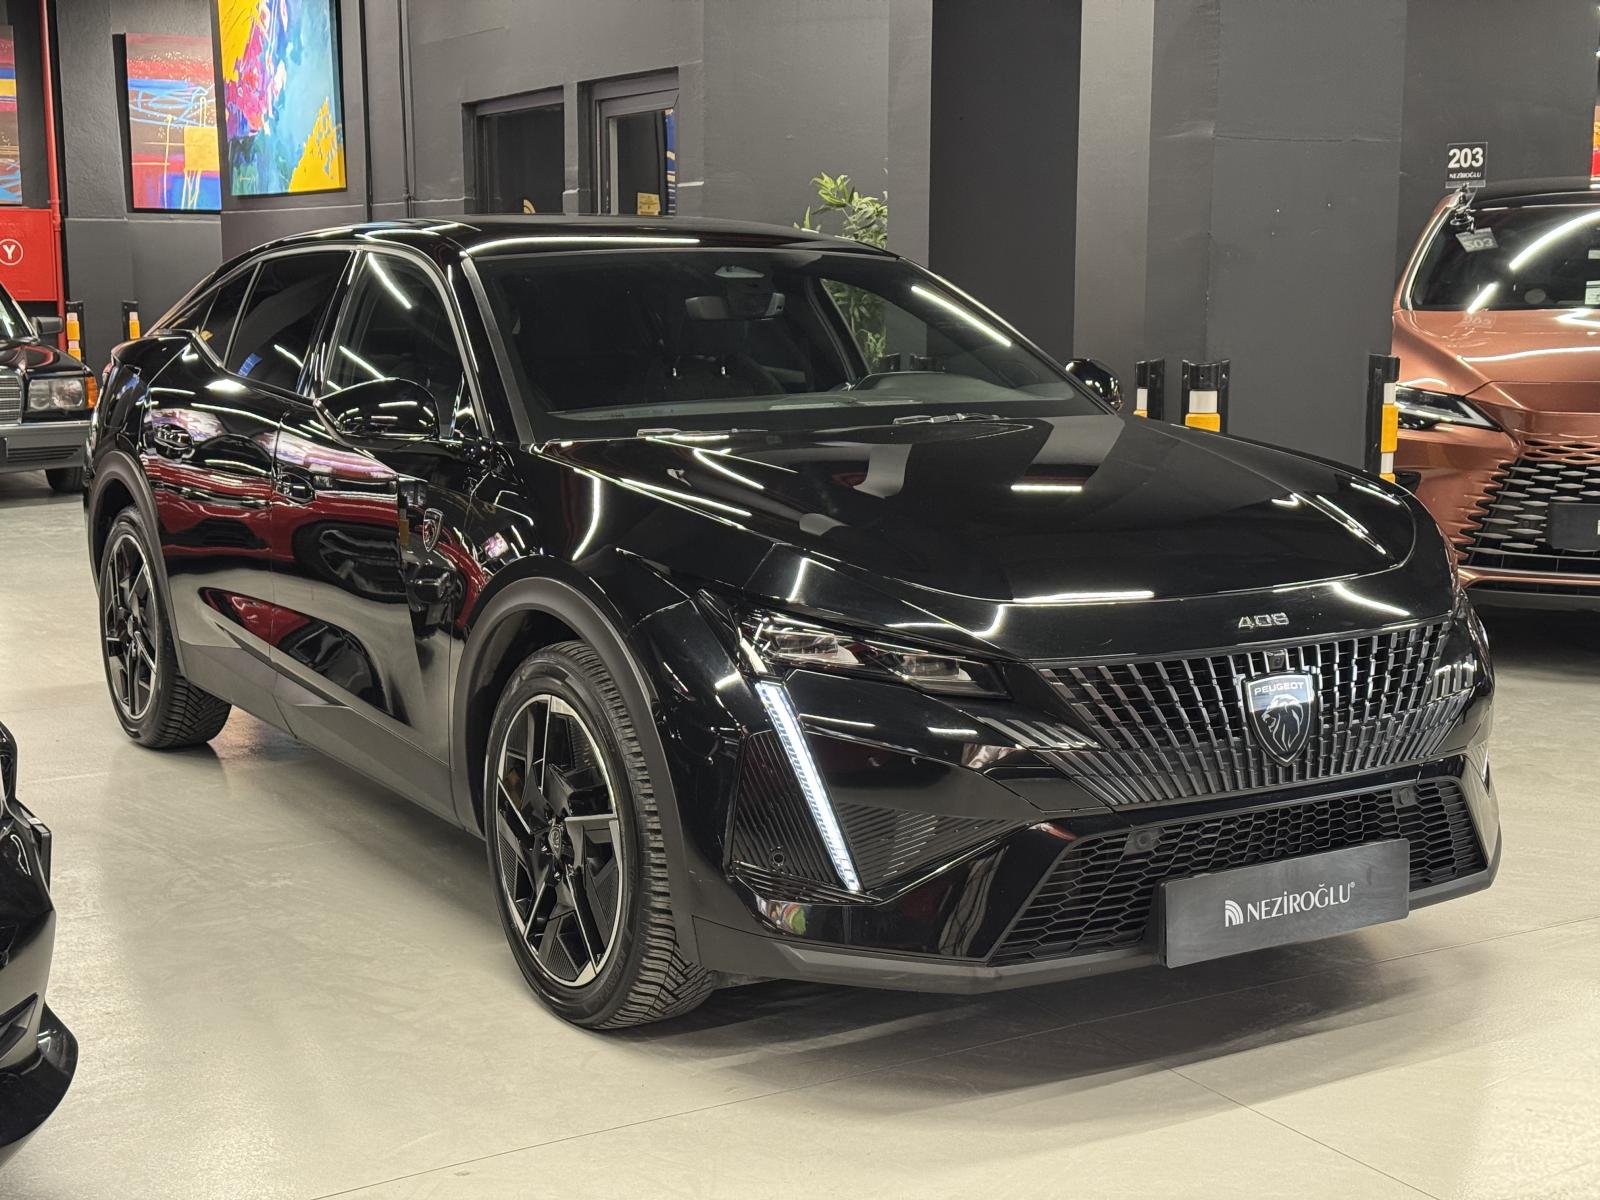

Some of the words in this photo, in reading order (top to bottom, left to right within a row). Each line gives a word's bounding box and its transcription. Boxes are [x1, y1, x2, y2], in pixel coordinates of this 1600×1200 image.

[1448, 147, 1484, 168] 203
[2, 244, 16, 260] Y
[1238, 612, 1289, 629] 408
[1254, 681, 1305, 696] PEUGEOT
